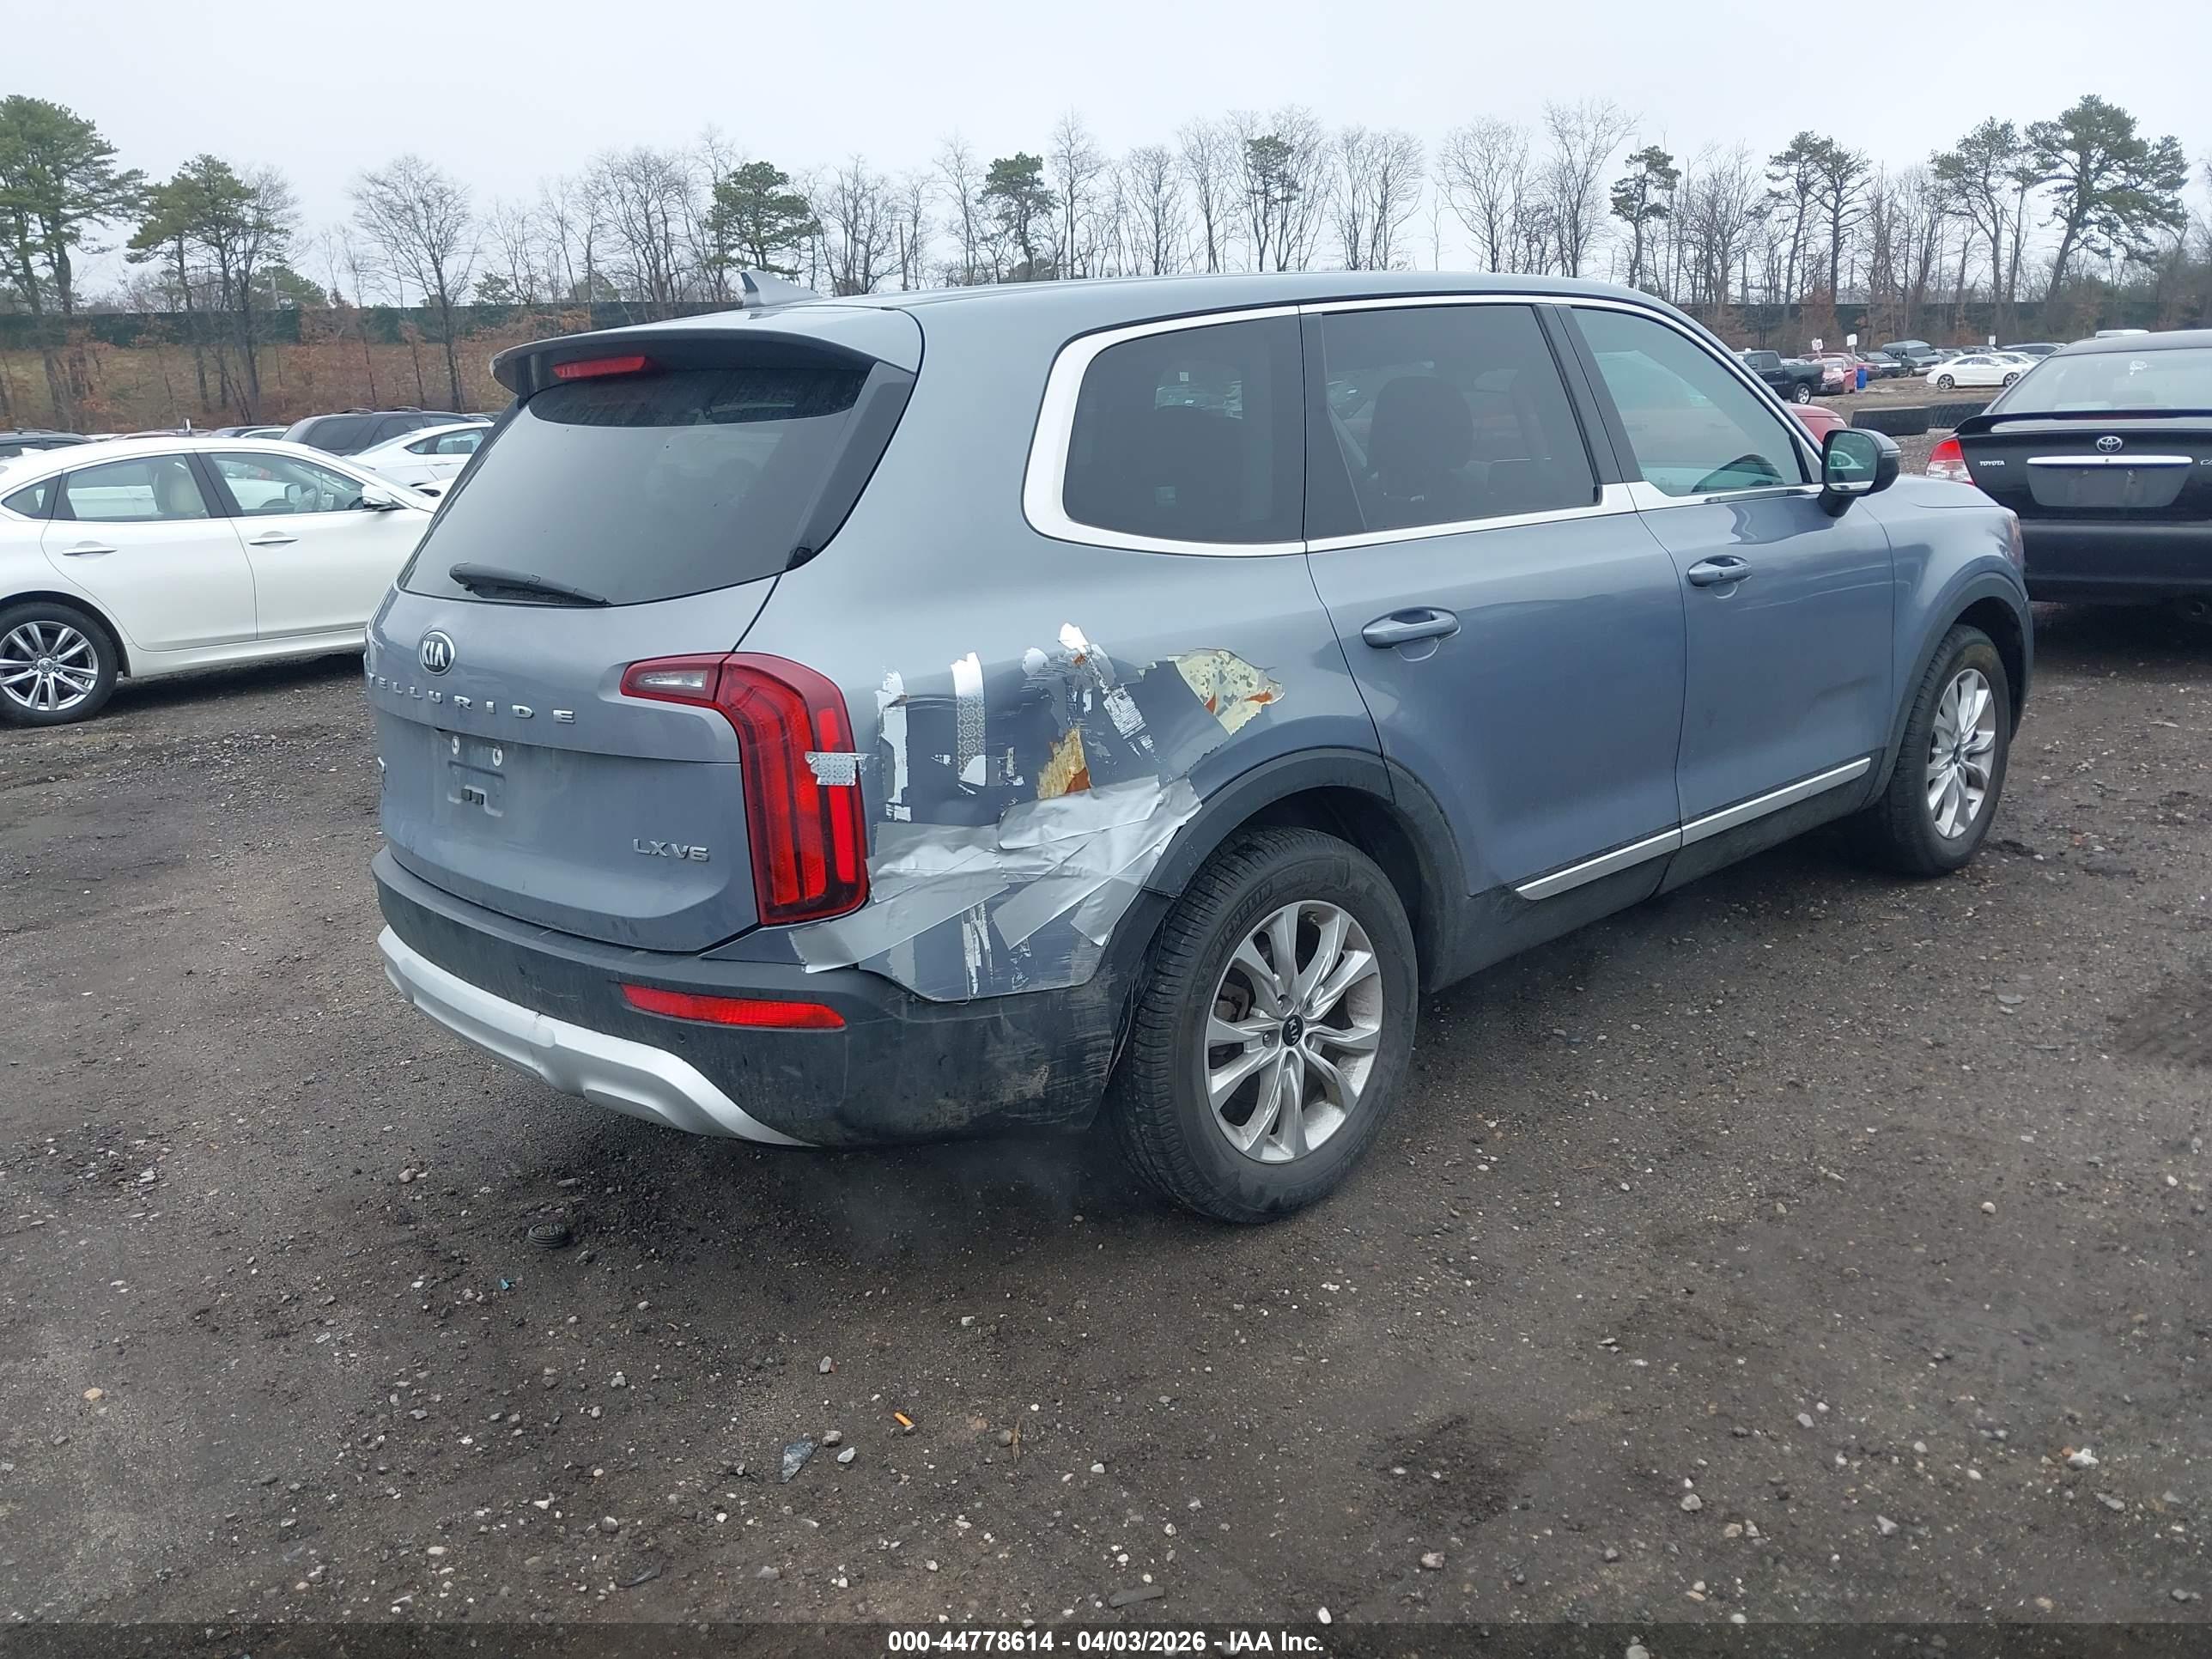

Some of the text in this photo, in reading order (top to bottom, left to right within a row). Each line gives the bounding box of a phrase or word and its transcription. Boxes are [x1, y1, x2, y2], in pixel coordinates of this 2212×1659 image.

[422, 641, 447, 667] KIA
[368, 672, 575, 724] TELLURIDE
[633, 838, 708, 862] LX V6
[1288, 1018, 1299, 1045] KIA
